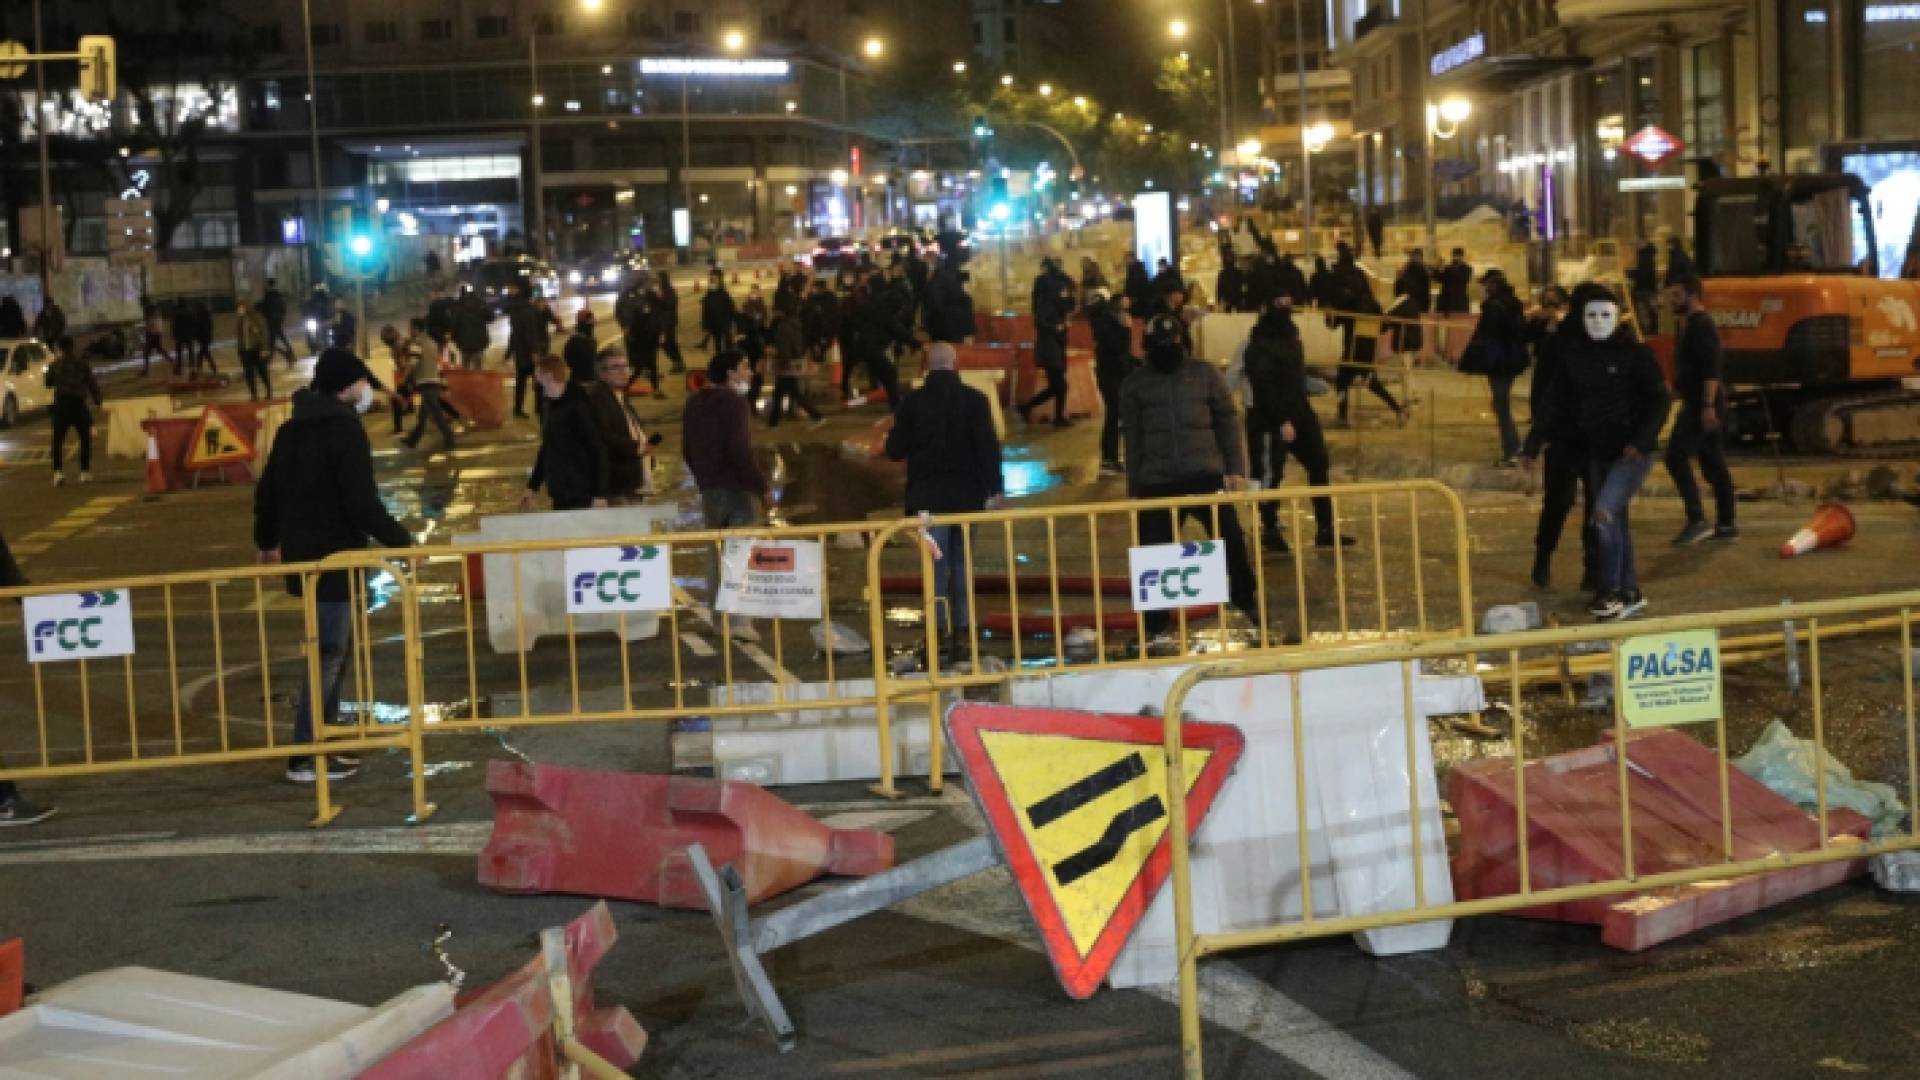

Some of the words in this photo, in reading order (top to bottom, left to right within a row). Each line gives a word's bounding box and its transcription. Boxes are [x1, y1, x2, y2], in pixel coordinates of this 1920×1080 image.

[573, 569, 641, 605] FCC
[1139, 565, 1200, 603] FCC
[33, 616, 102, 654] FCC
[1628, 647, 1713, 681] PACSA
